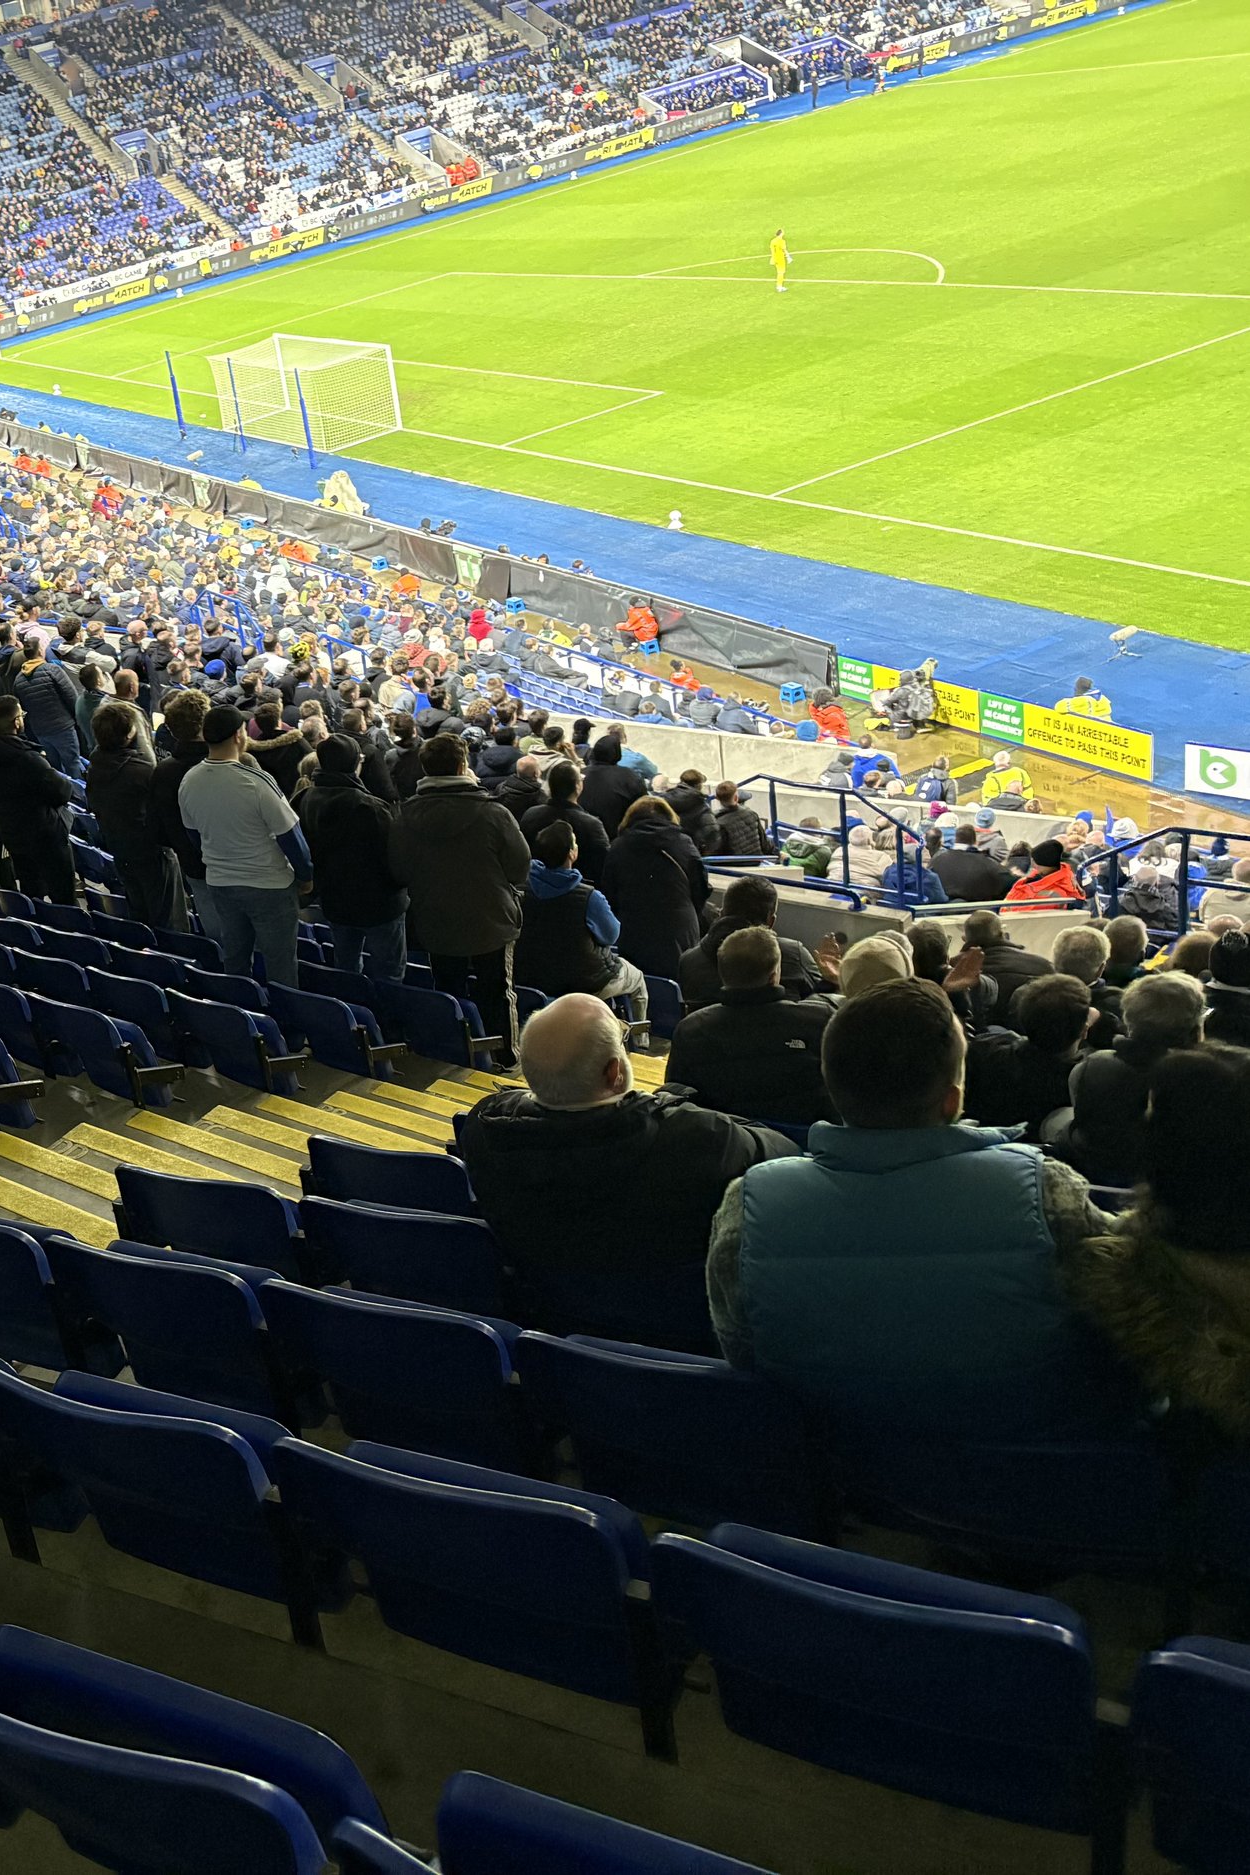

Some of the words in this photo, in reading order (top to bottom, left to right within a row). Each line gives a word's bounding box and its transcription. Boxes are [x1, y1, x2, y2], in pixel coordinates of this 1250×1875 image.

[1027, 727, 1063, 746] OFFENCE
[1065, 736, 1075, 748] TO
[1077, 740, 1098, 755] PASS
[1099, 746, 1118, 761] THIS
[1120, 752, 1147, 769] POINT
[1043, 717, 1051, 727] IT
[1053, 719, 1061, 730] IS
[1063, 721, 1074, 733] AN
[1076, 725, 1129, 748] ARRESTABLE
